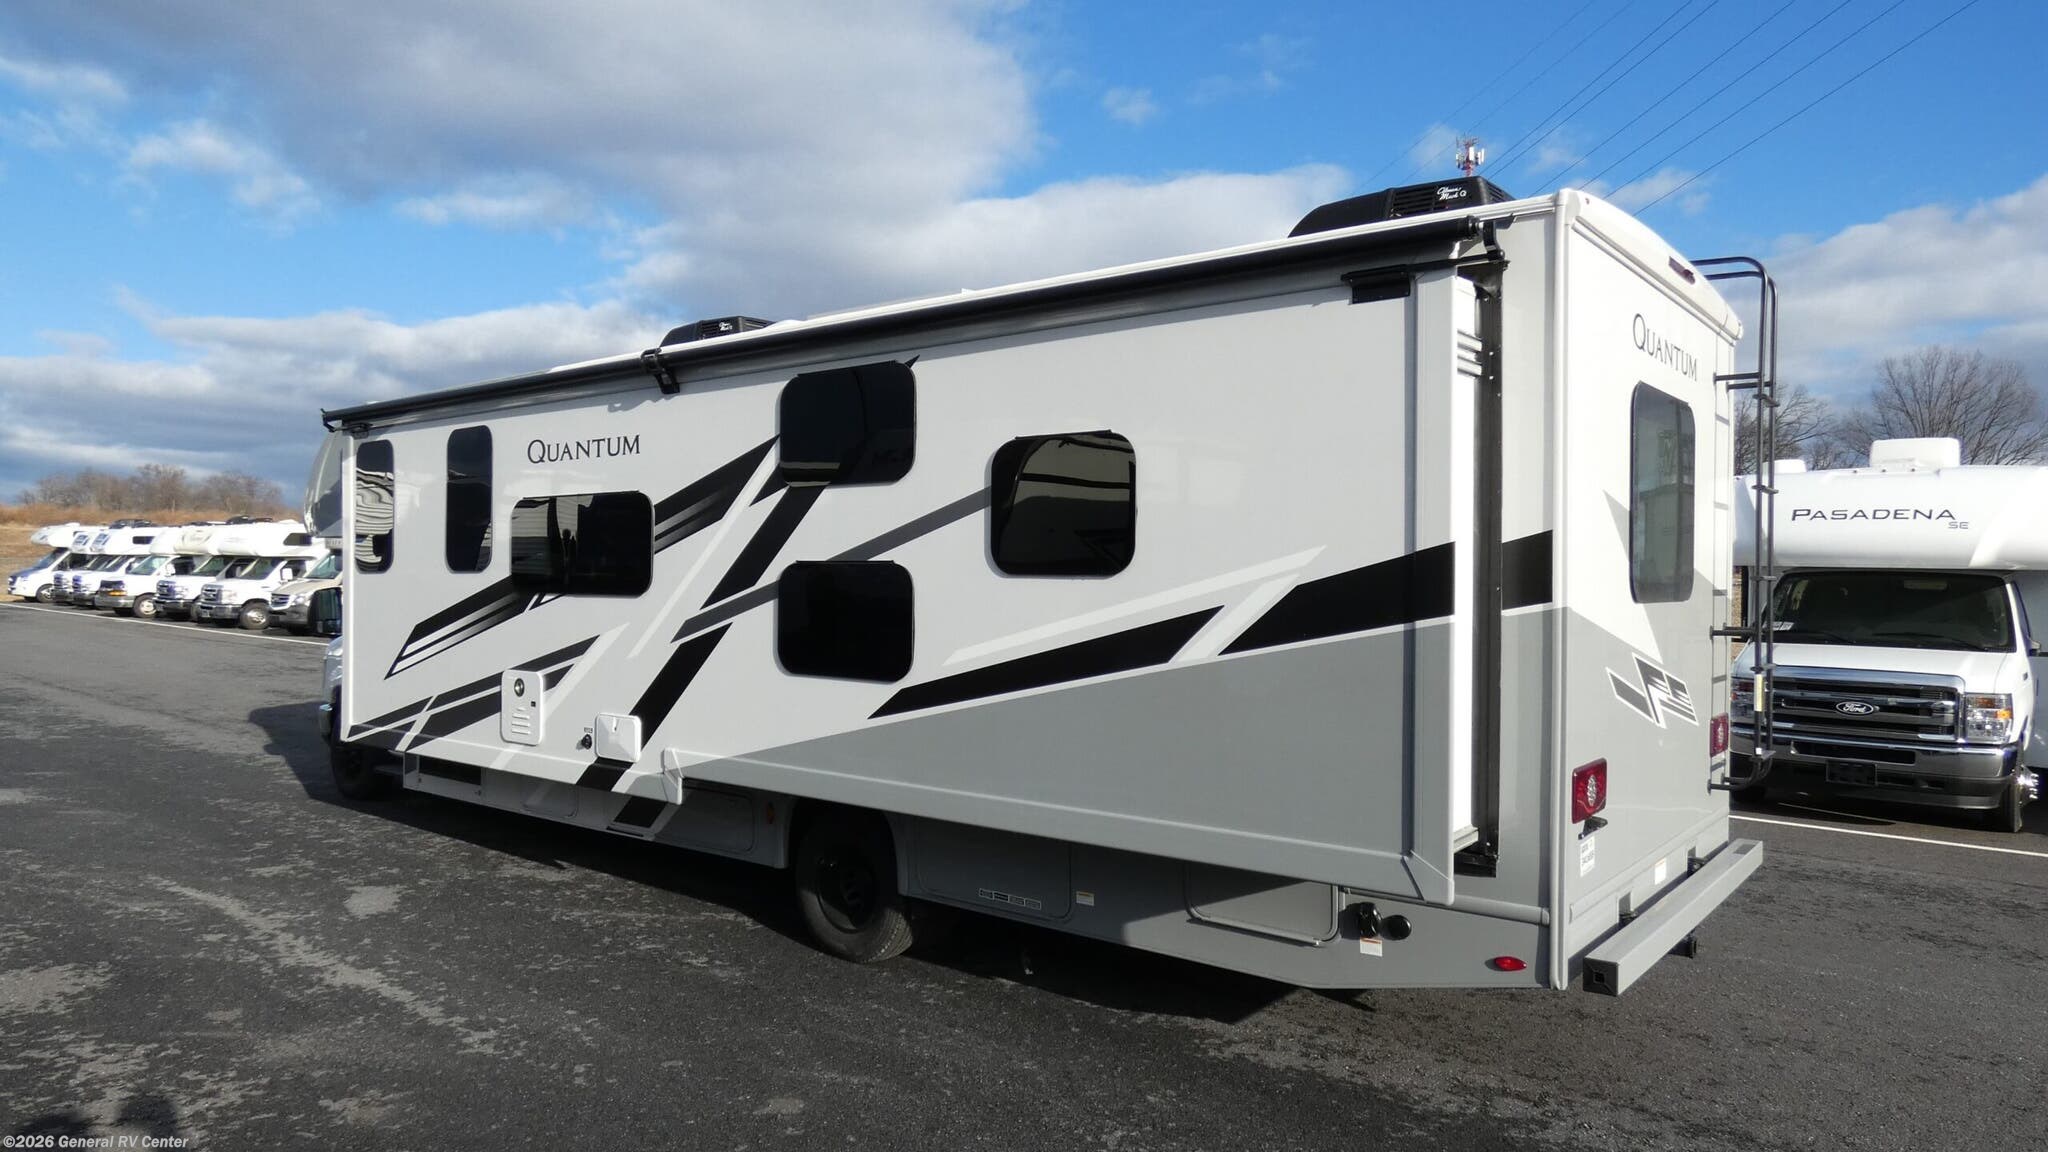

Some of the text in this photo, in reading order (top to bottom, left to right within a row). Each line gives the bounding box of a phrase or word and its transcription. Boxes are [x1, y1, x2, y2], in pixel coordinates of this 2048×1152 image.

[1633, 313, 1697, 382] QUANTUM
[527, 434, 641, 464] QUANTUM
[1791, 509, 1956, 521] PASADENA
[1948, 521, 1969, 530] SE
[1842, 702, 1867, 713] Ford
